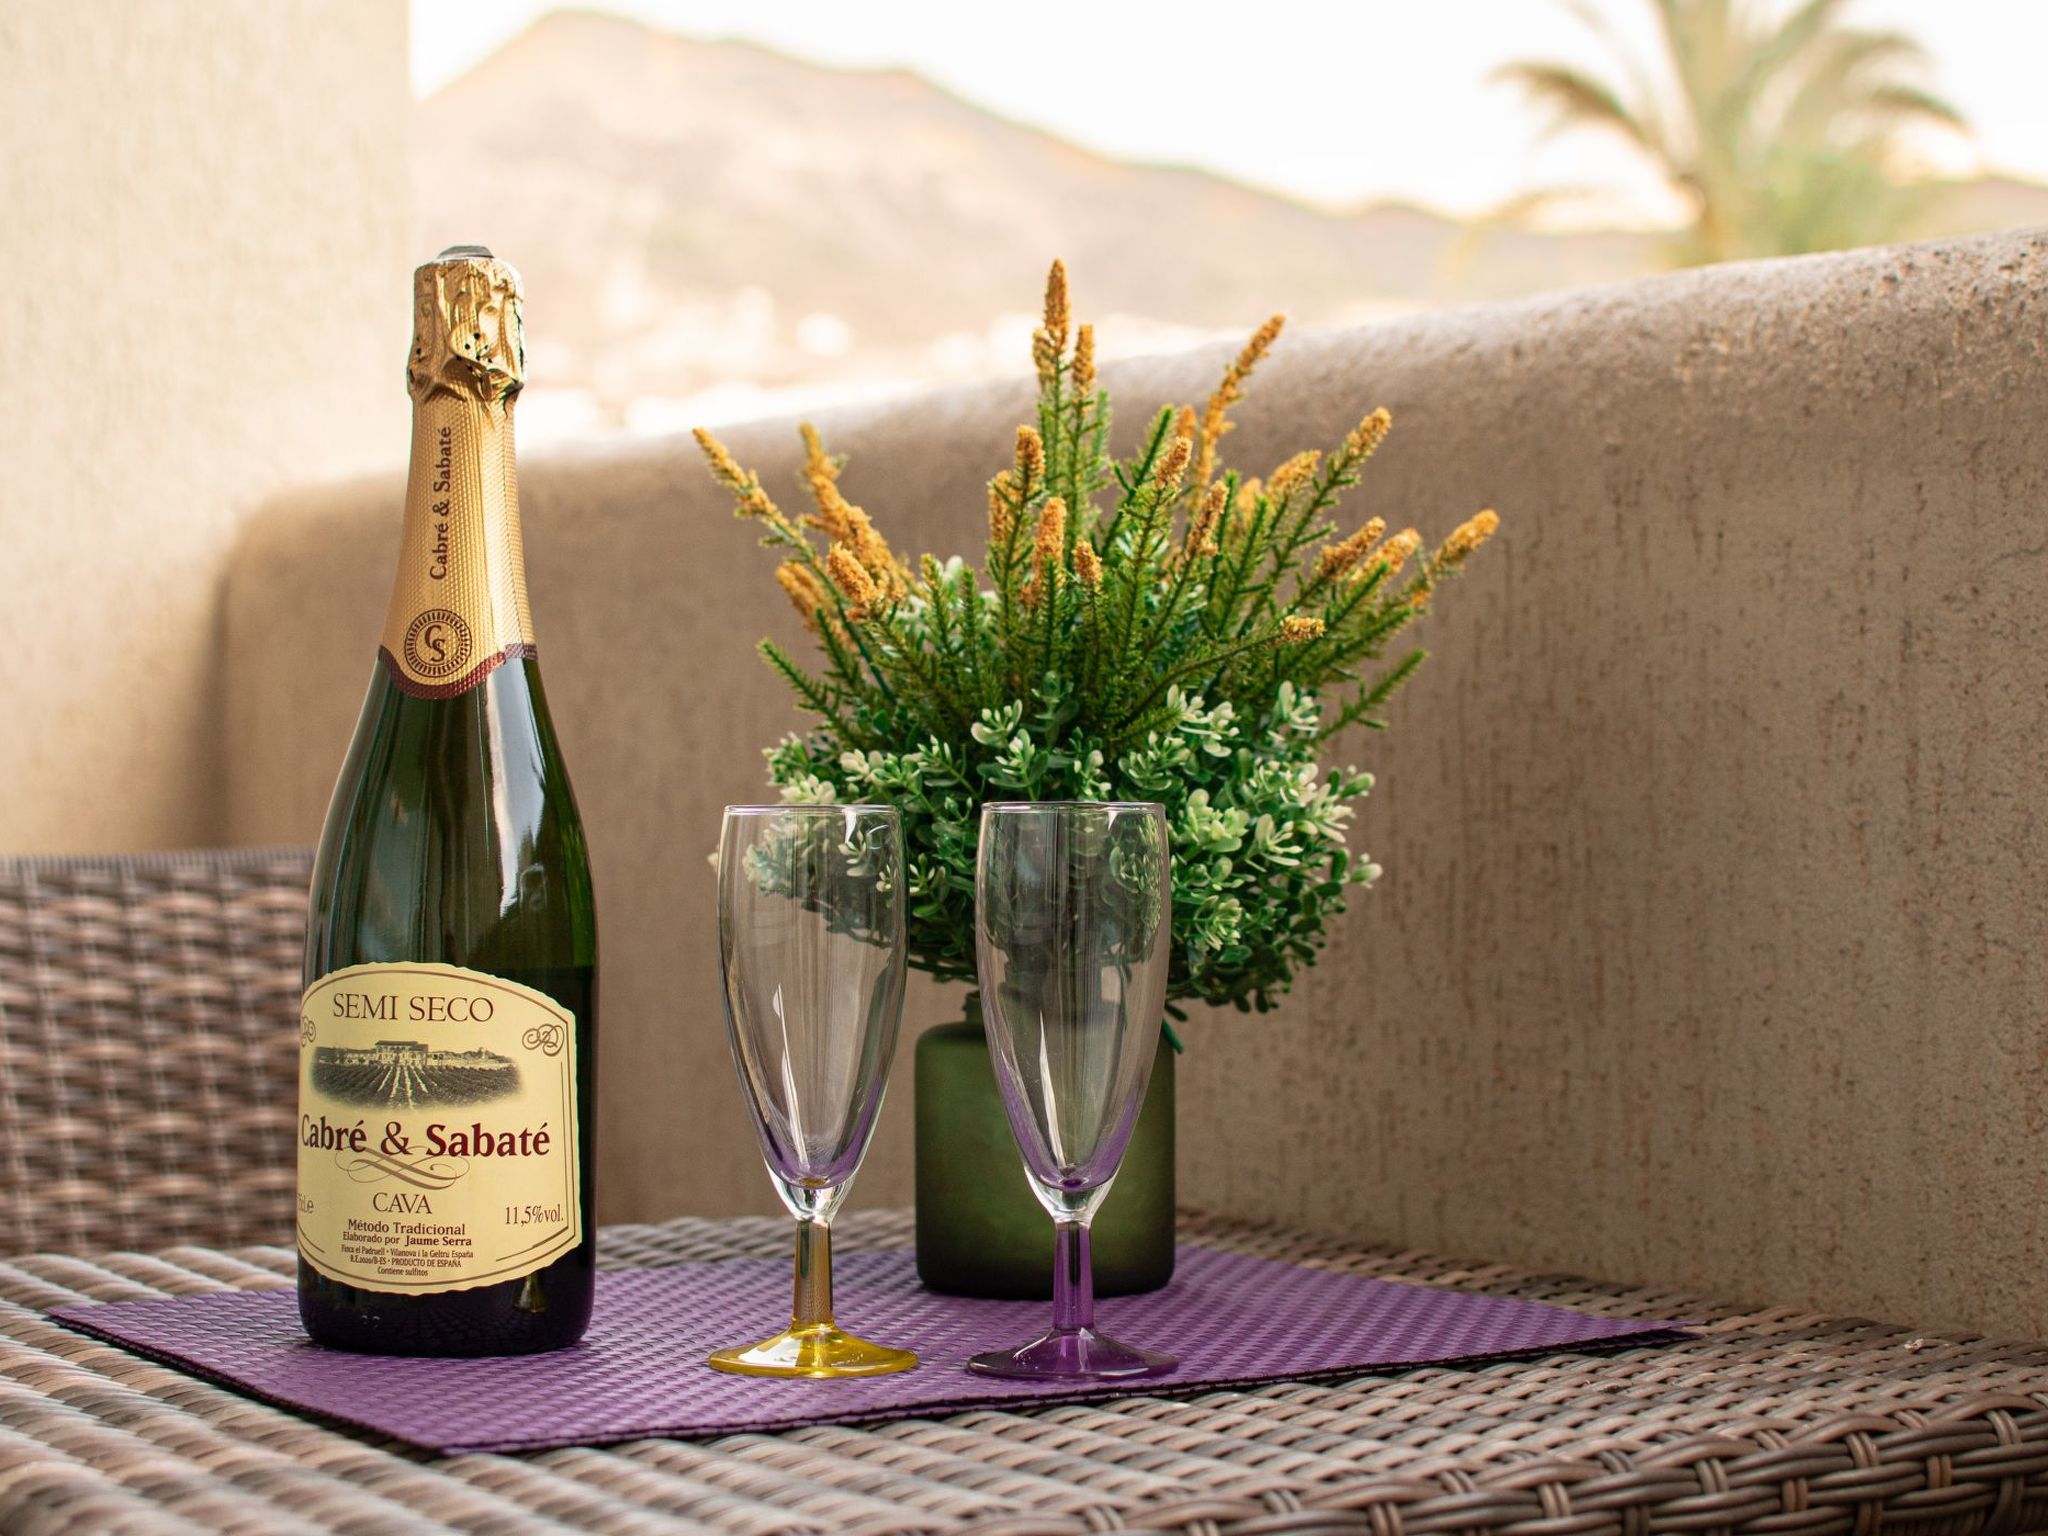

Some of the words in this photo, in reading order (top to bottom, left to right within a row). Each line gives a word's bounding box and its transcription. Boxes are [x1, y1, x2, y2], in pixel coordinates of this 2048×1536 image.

[433, 427, 452, 493] Sabaté
[432, 499, 449, 517] &
[430, 523, 449, 580] Cabré
[333, 993, 399, 1020] SEMI
[409, 996, 494, 1022] SECO
[301, 1114, 367, 1154] Cabré
[380, 1121, 413, 1155] &
[426, 1122, 550, 1157] Sabaté
[373, 1192, 432, 1214] CAVA
[348, 1219, 390, 1232] Método
[393, 1222, 466, 1236] Tradicional
[343, 1231, 383, 1243] Elaborado
[385, 1235, 400, 1246] por
[404, 1235, 439, 1247] Jaume
[442, 1236, 472, 1246] Serra
[390, 1248, 417, 1258] Vilanova
[422, 1249, 429, 1258] la
[452, 1250, 474, 1260] España
[391, 1257, 426, 1267] PRODUCTO
[427, 1259, 435, 1268] DE
[437, 1258, 462, 1268] ESPAÑA
[377, 1266, 404, 1276] Contiene
[405, 1267, 429, 1277] sulfitos
